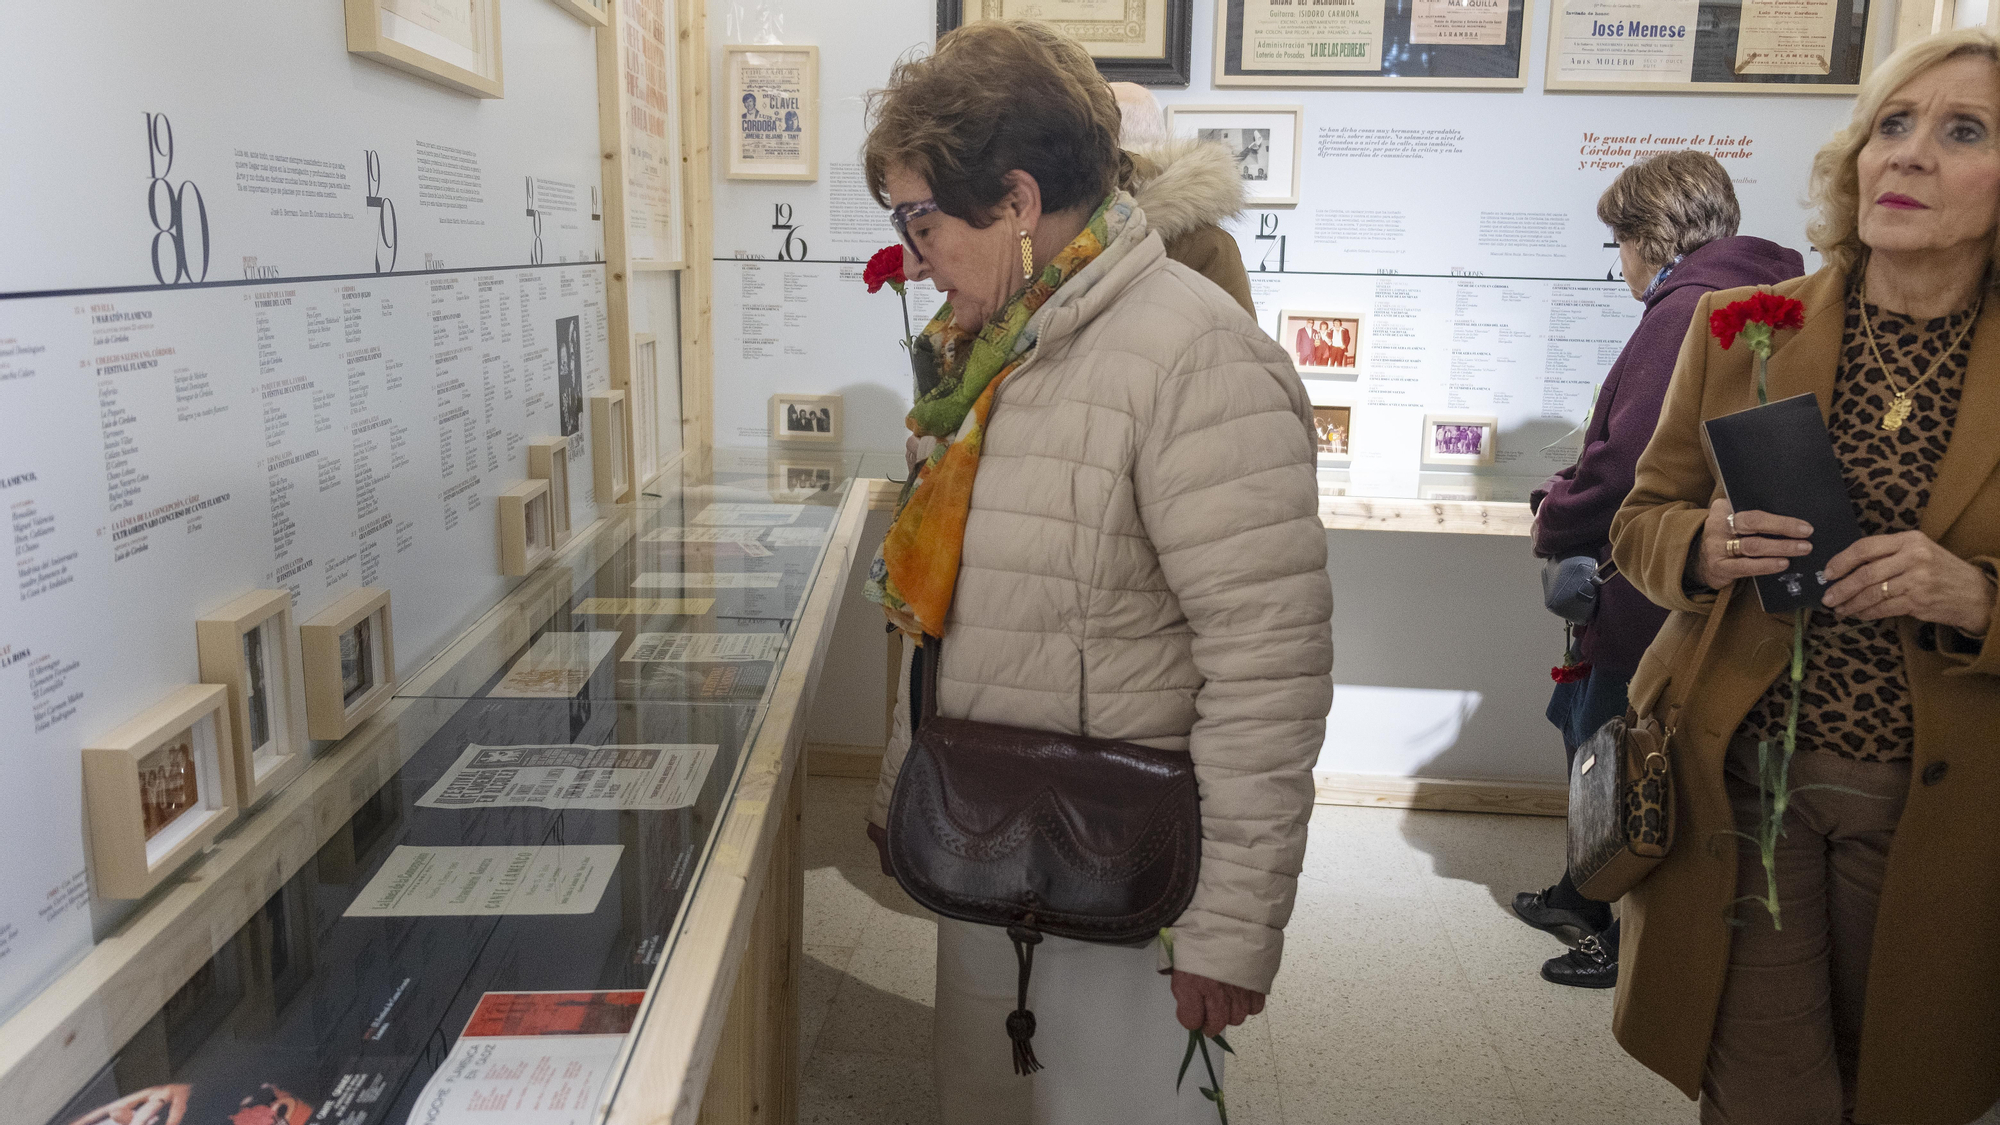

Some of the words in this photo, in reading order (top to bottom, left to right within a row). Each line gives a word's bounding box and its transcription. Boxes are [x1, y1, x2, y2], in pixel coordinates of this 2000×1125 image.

[1592, 20, 1624, 37] José
[1628, 20, 1686, 38] Menese
[1258, 40, 1304, 48] Administración
[1276, 50, 1282, 58] de
[1284, 50, 1305, 58] Posadas
[1597, 58, 1635, 66] MOLERO
[770, 97, 800, 110] CLAVEL
[742, 120, 777, 132] CORDOBA
[141, 112, 174, 178] 19
[1581, 132, 1600, 144] Me
[1600, 134, 1637, 146] gusta
[1640, 134, 1652, 144] el
[1654, 136, 1688, 146] cante
[1690, 134, 1706, 146] de
[1708, 134, 1735, 146] Luis
[1738, 135, 1753, 146] de
[1580, 145, 1632, 156] Córdoba
[1634, 150, 1676, 159] porqu
[1713, 148, 1753, 158] jarabe
[364, 150, 380, 197] 19
[1578, 160, 1588, 170] y
[1590, 158, 1626, 171] rigor.
[524, 176, 534, 209] 19
[772, 202, 792, 226] 19
[148, 178, 210, 284] 80
[1259, 212, 1278, 236] 19
[366, 196, 398, 272] 79
[526, 208, 543, 265] 78
[772, 224, 808, 261] 76
[124, 310, 152, 320] FLAMENCO
[110, 334, 130, 343] Córdoba
[104, 362, 129, 375] FESTIVAL
[130, 359, 158, 372] FLAMENCO
[118, 415, 137, 426] Córdoba
[159, 508, 184, 524] CONCURSO
[191, 500, 206, 514] CANTE
[206, 493, 231, 508] FLAMENCO
[497, 852, 533, 885] FLAMENCO
[483, 888, 512, 908] CANTE
